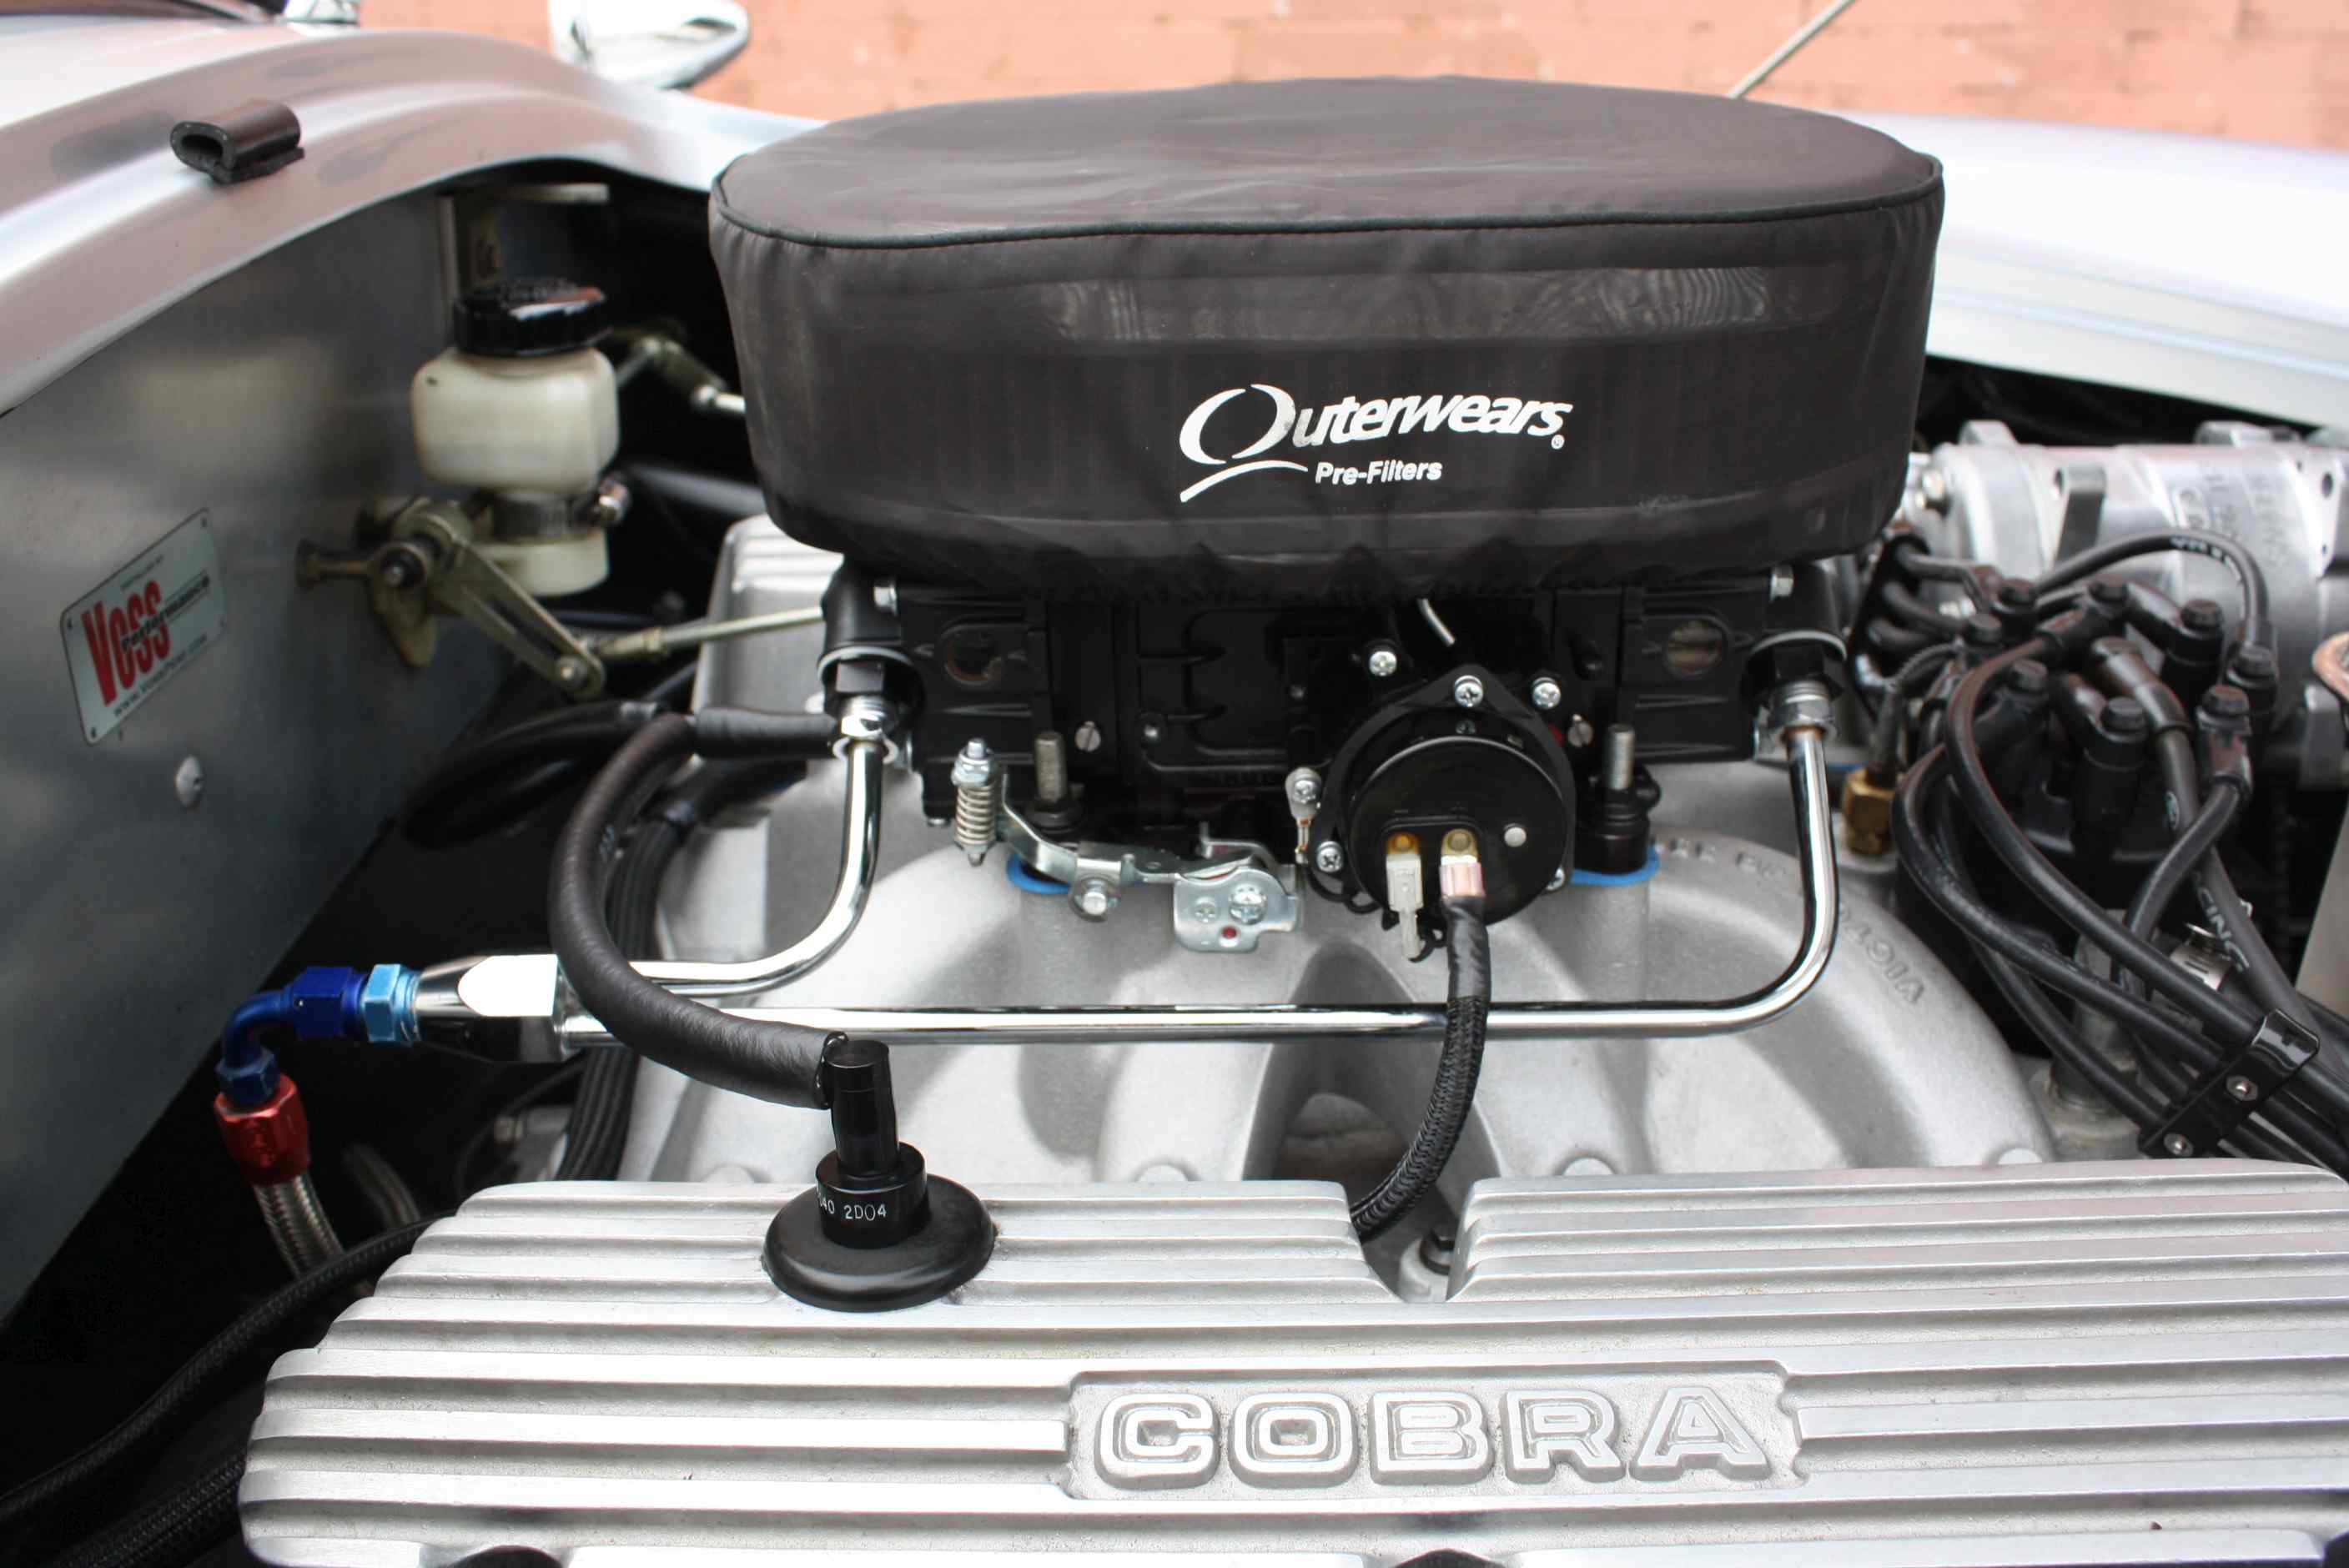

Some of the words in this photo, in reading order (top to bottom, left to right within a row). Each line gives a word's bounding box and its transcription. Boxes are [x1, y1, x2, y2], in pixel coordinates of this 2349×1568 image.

[1179, 384, 1573, 465] Outerwears
[1315, 461, 1443, 485] Pre-Filters
[1094, 1386, 1773, 1491] COBRA
